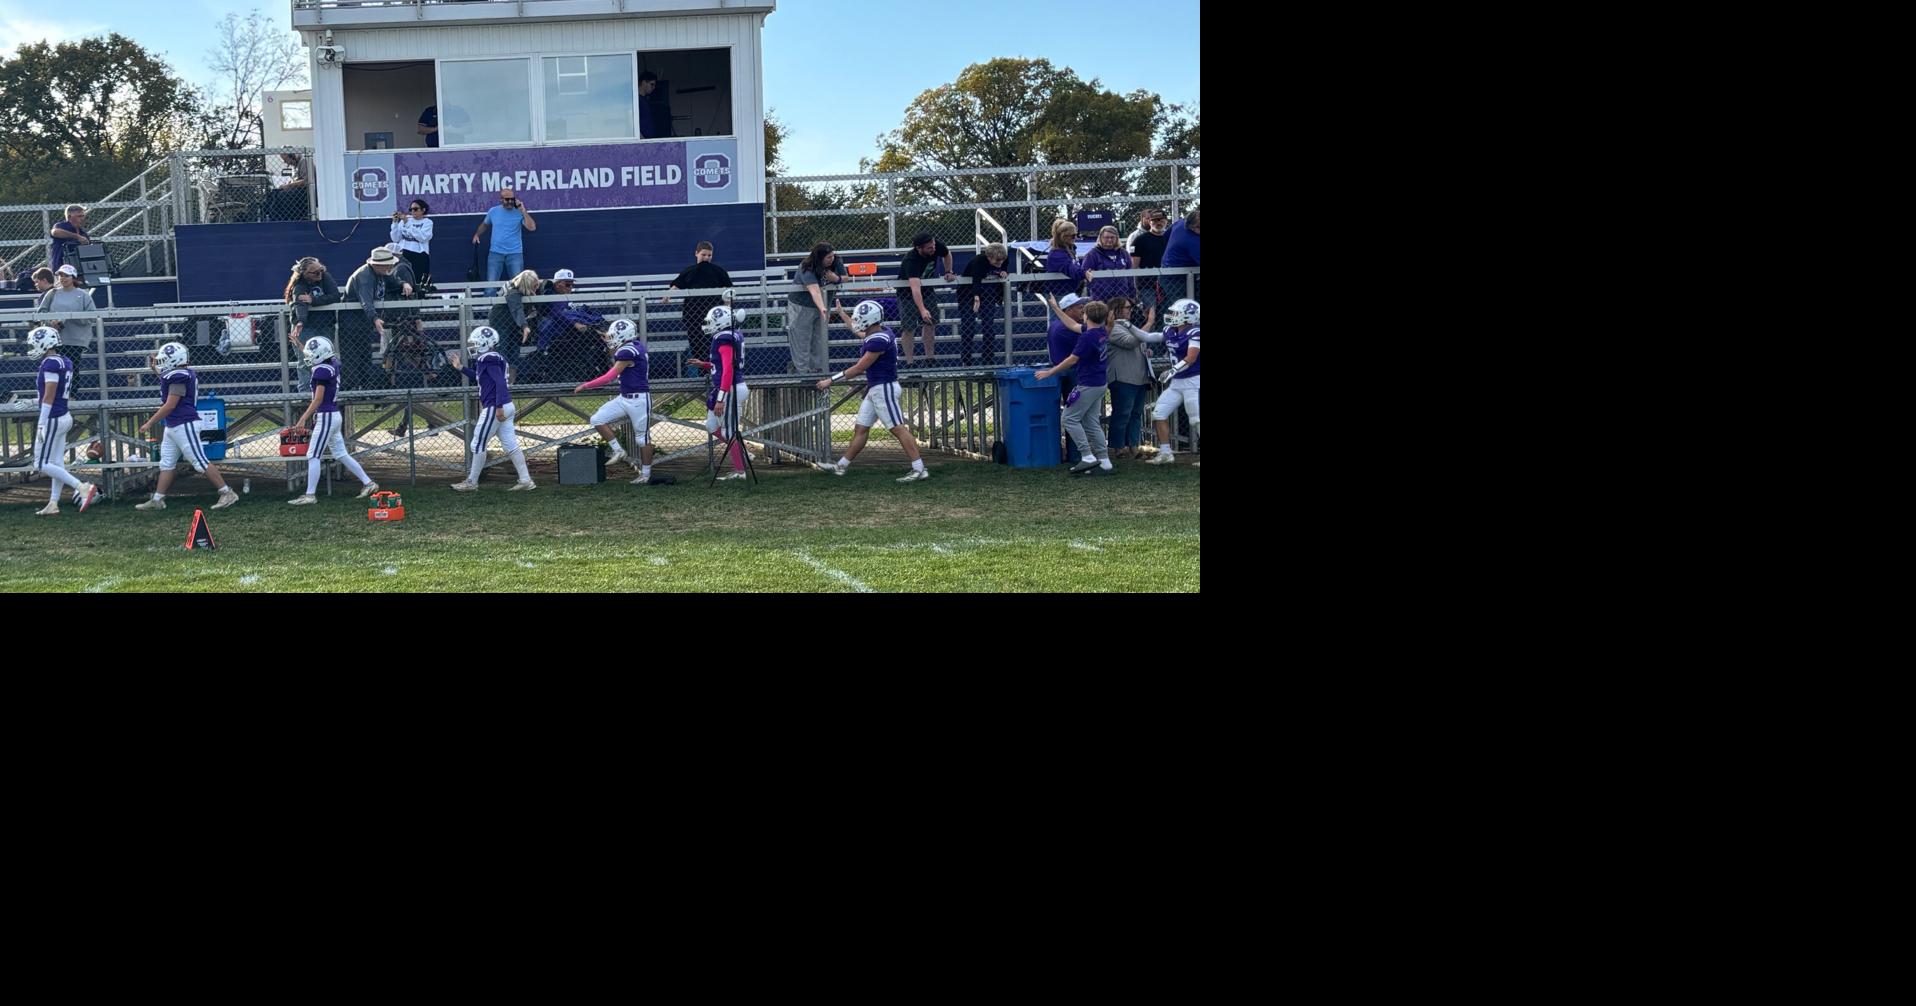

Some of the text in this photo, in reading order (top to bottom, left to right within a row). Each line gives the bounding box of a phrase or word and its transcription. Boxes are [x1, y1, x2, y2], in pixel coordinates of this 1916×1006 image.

[401, 164, 682, 195] MARTY McFARLAND FIELD
[693, 167, 731, 176] COMETS
